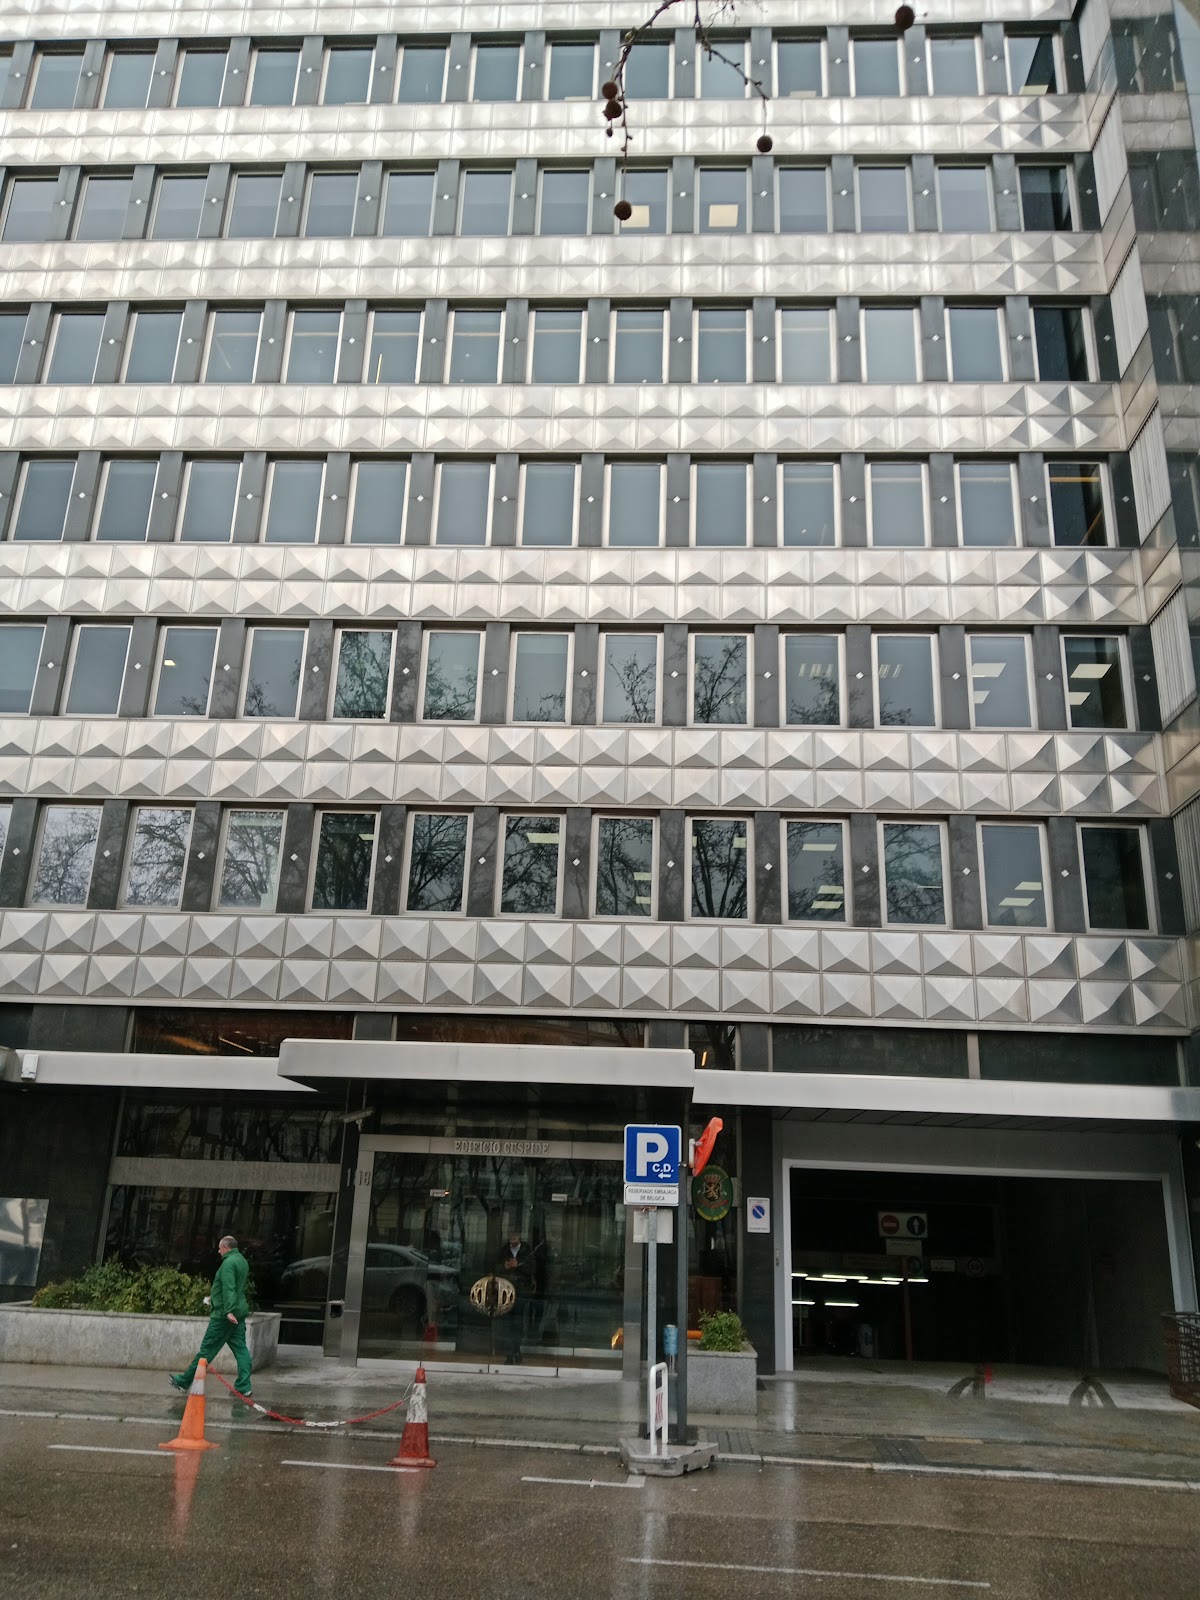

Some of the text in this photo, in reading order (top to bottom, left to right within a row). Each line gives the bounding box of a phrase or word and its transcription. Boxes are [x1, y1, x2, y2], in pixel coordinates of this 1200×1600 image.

[455, 1140, 549, 1155] EDIFICIO CUSPIDE
[636, 1132, 669, 1177] P
[652, 1163, 674, 1173] C.D.
